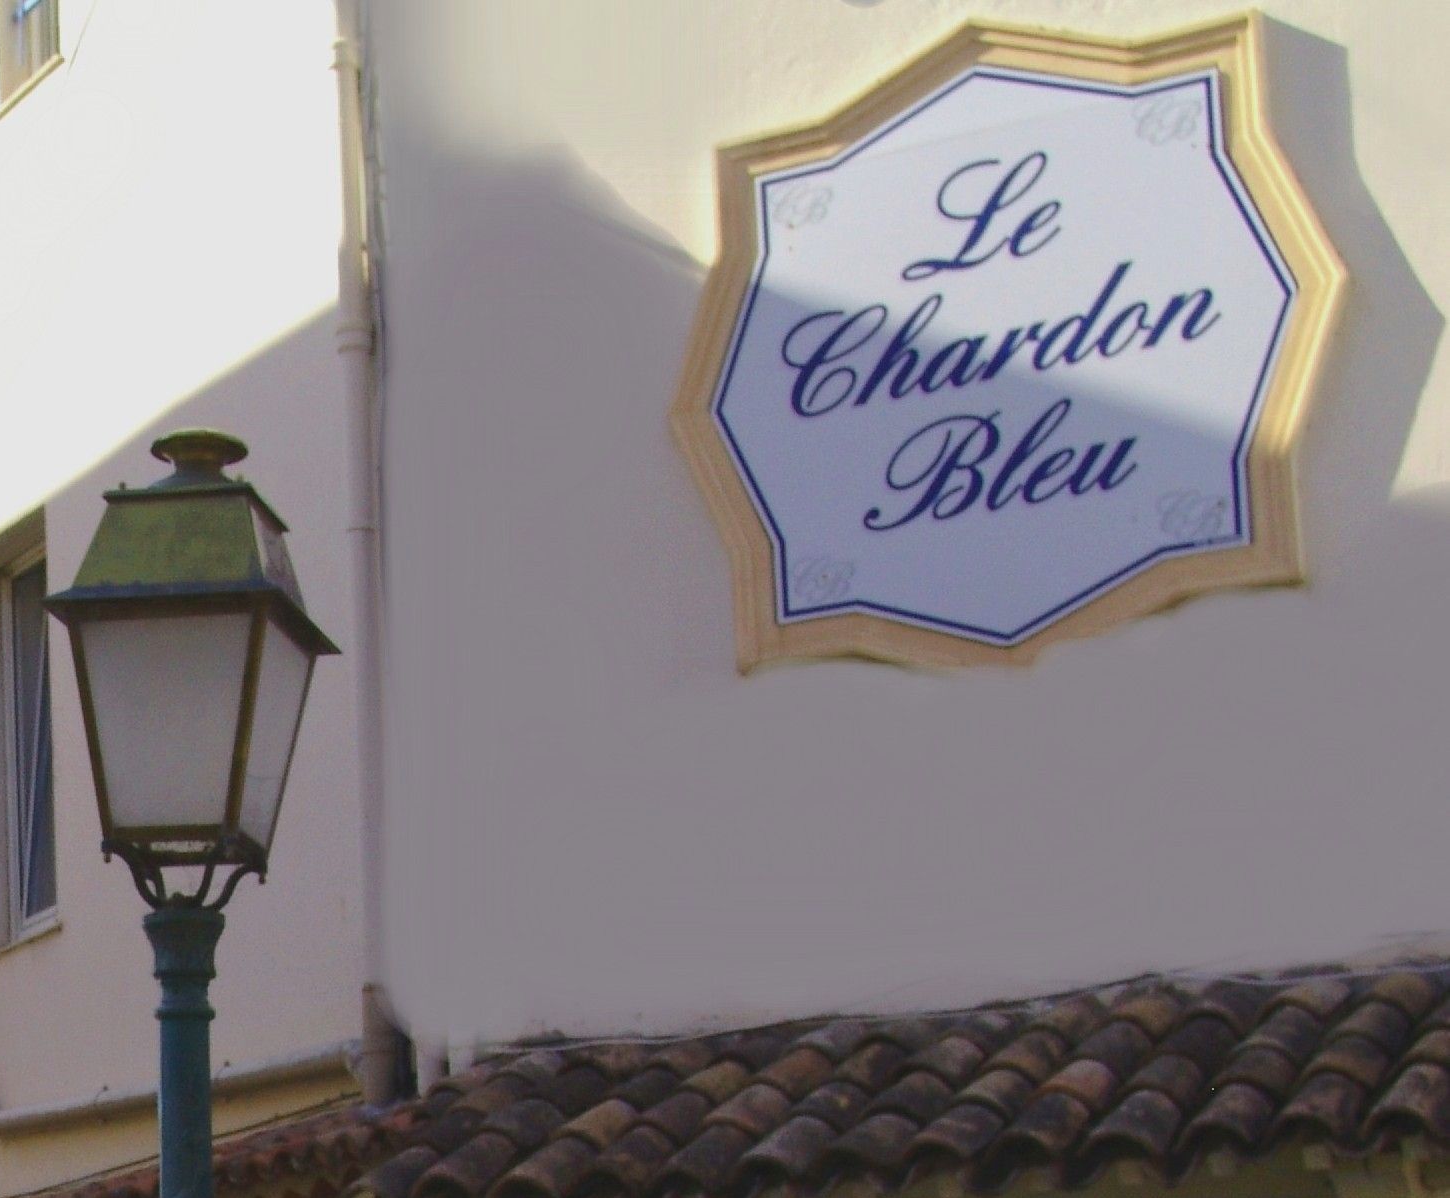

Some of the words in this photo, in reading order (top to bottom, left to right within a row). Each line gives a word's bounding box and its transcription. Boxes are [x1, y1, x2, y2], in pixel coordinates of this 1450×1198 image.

[901, 151, 1062, 281] Le
[781, 261, 1222, 418] Chardon
[862, 399, 1138, 531] Bleu
